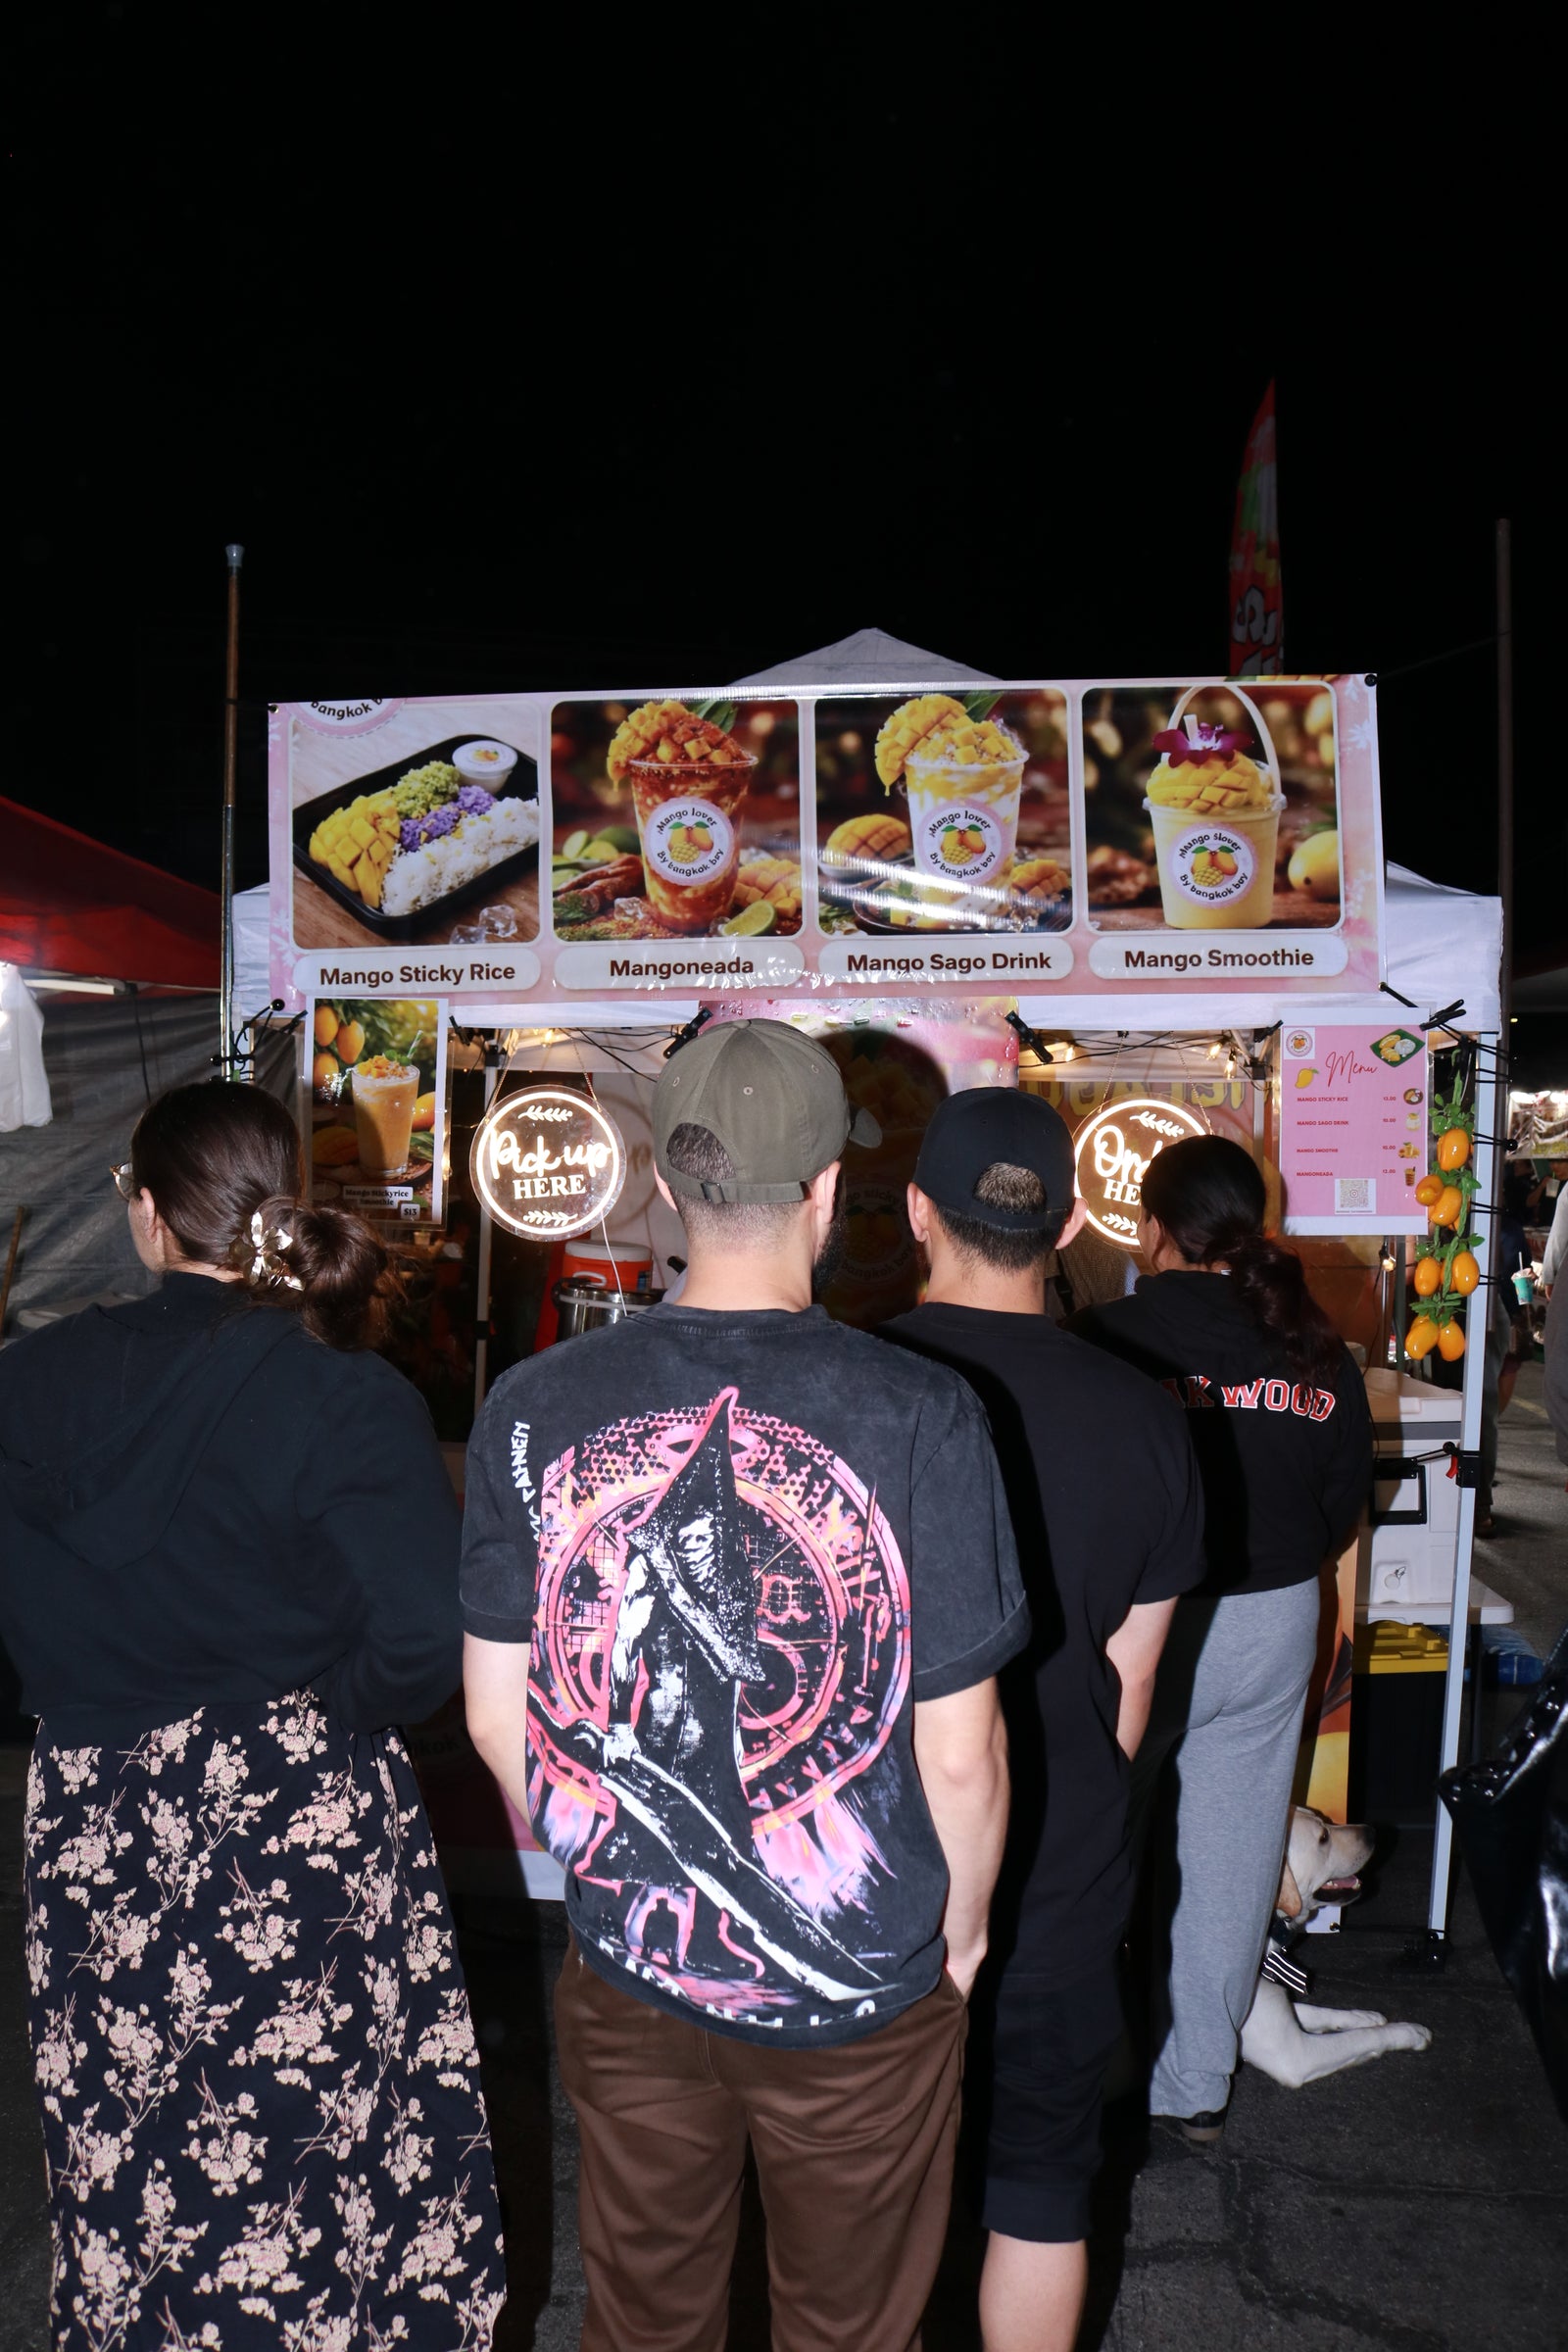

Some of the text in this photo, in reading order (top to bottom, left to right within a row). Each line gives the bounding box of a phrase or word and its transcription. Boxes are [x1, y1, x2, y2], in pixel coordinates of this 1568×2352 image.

[929, 812, 961, 838] Mango
[940, 863, 982, 878] bangkok
[981, 852, 996, 867] boy
[1180, 874, 1191, 887] By
[1190, 885, 1234, 901] bangkok
[610, 956, 754, 980] Mangoneada
[847, 953, 1052, 974] Mango Sago Drink
[1124, 949, 1314, 972] Mango Smoothie
[319, 963, 515, 988] Mango Sticky Rice
[1325, 1050, 1378, 1088] Menu
[489, 1127, 612, 1180] Pick up
[345, 1189, 370, 1198] Mango
[512, 1175, 587, 1200] HERE
[403, 1207, 417, 1216] $13
